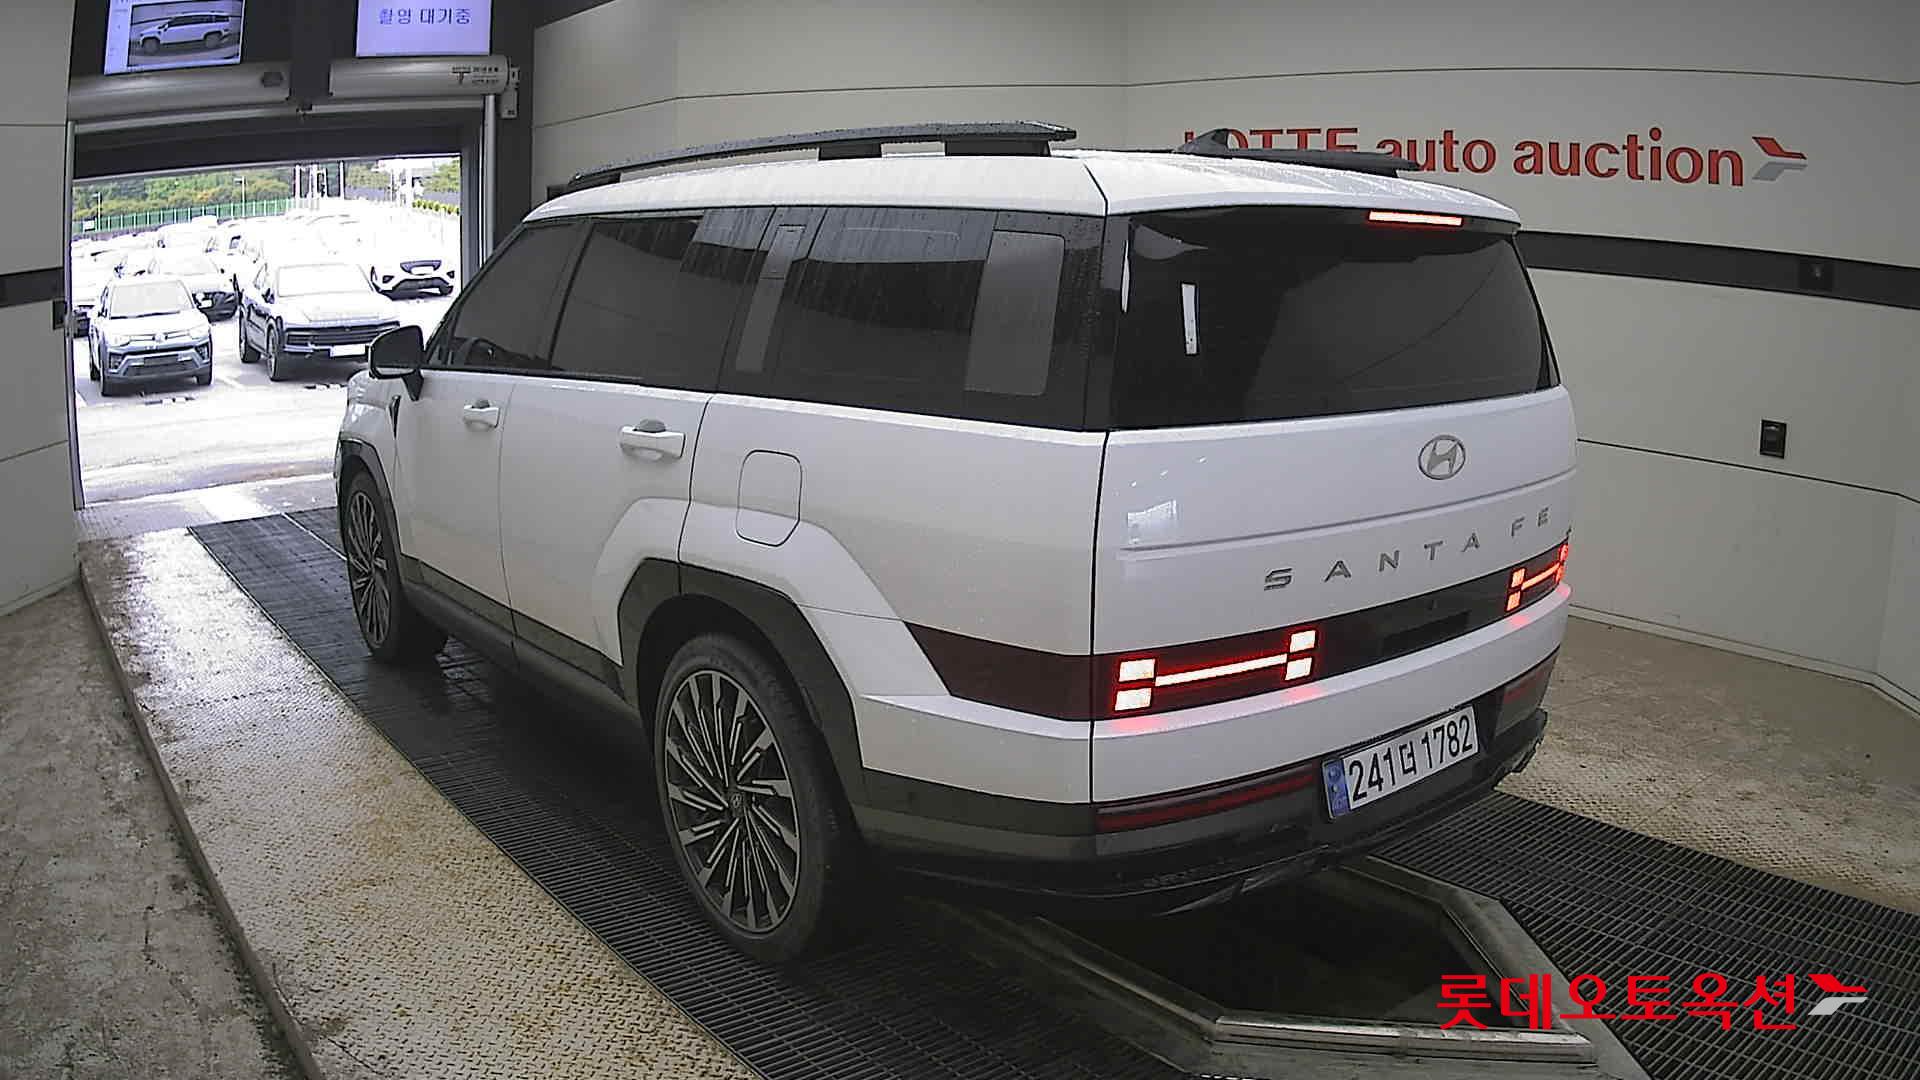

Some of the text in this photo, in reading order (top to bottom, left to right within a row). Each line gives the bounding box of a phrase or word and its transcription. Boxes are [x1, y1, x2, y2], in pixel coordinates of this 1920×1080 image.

[419, 8, 472, 25] 대기중
[1184, 127, 1358, 152] TTE
[1514, 127, 1744, 187] auction
[1263, 506, 1550, 592] SANTA FE
[1349, 714, 1474, 802] 241더 1782
